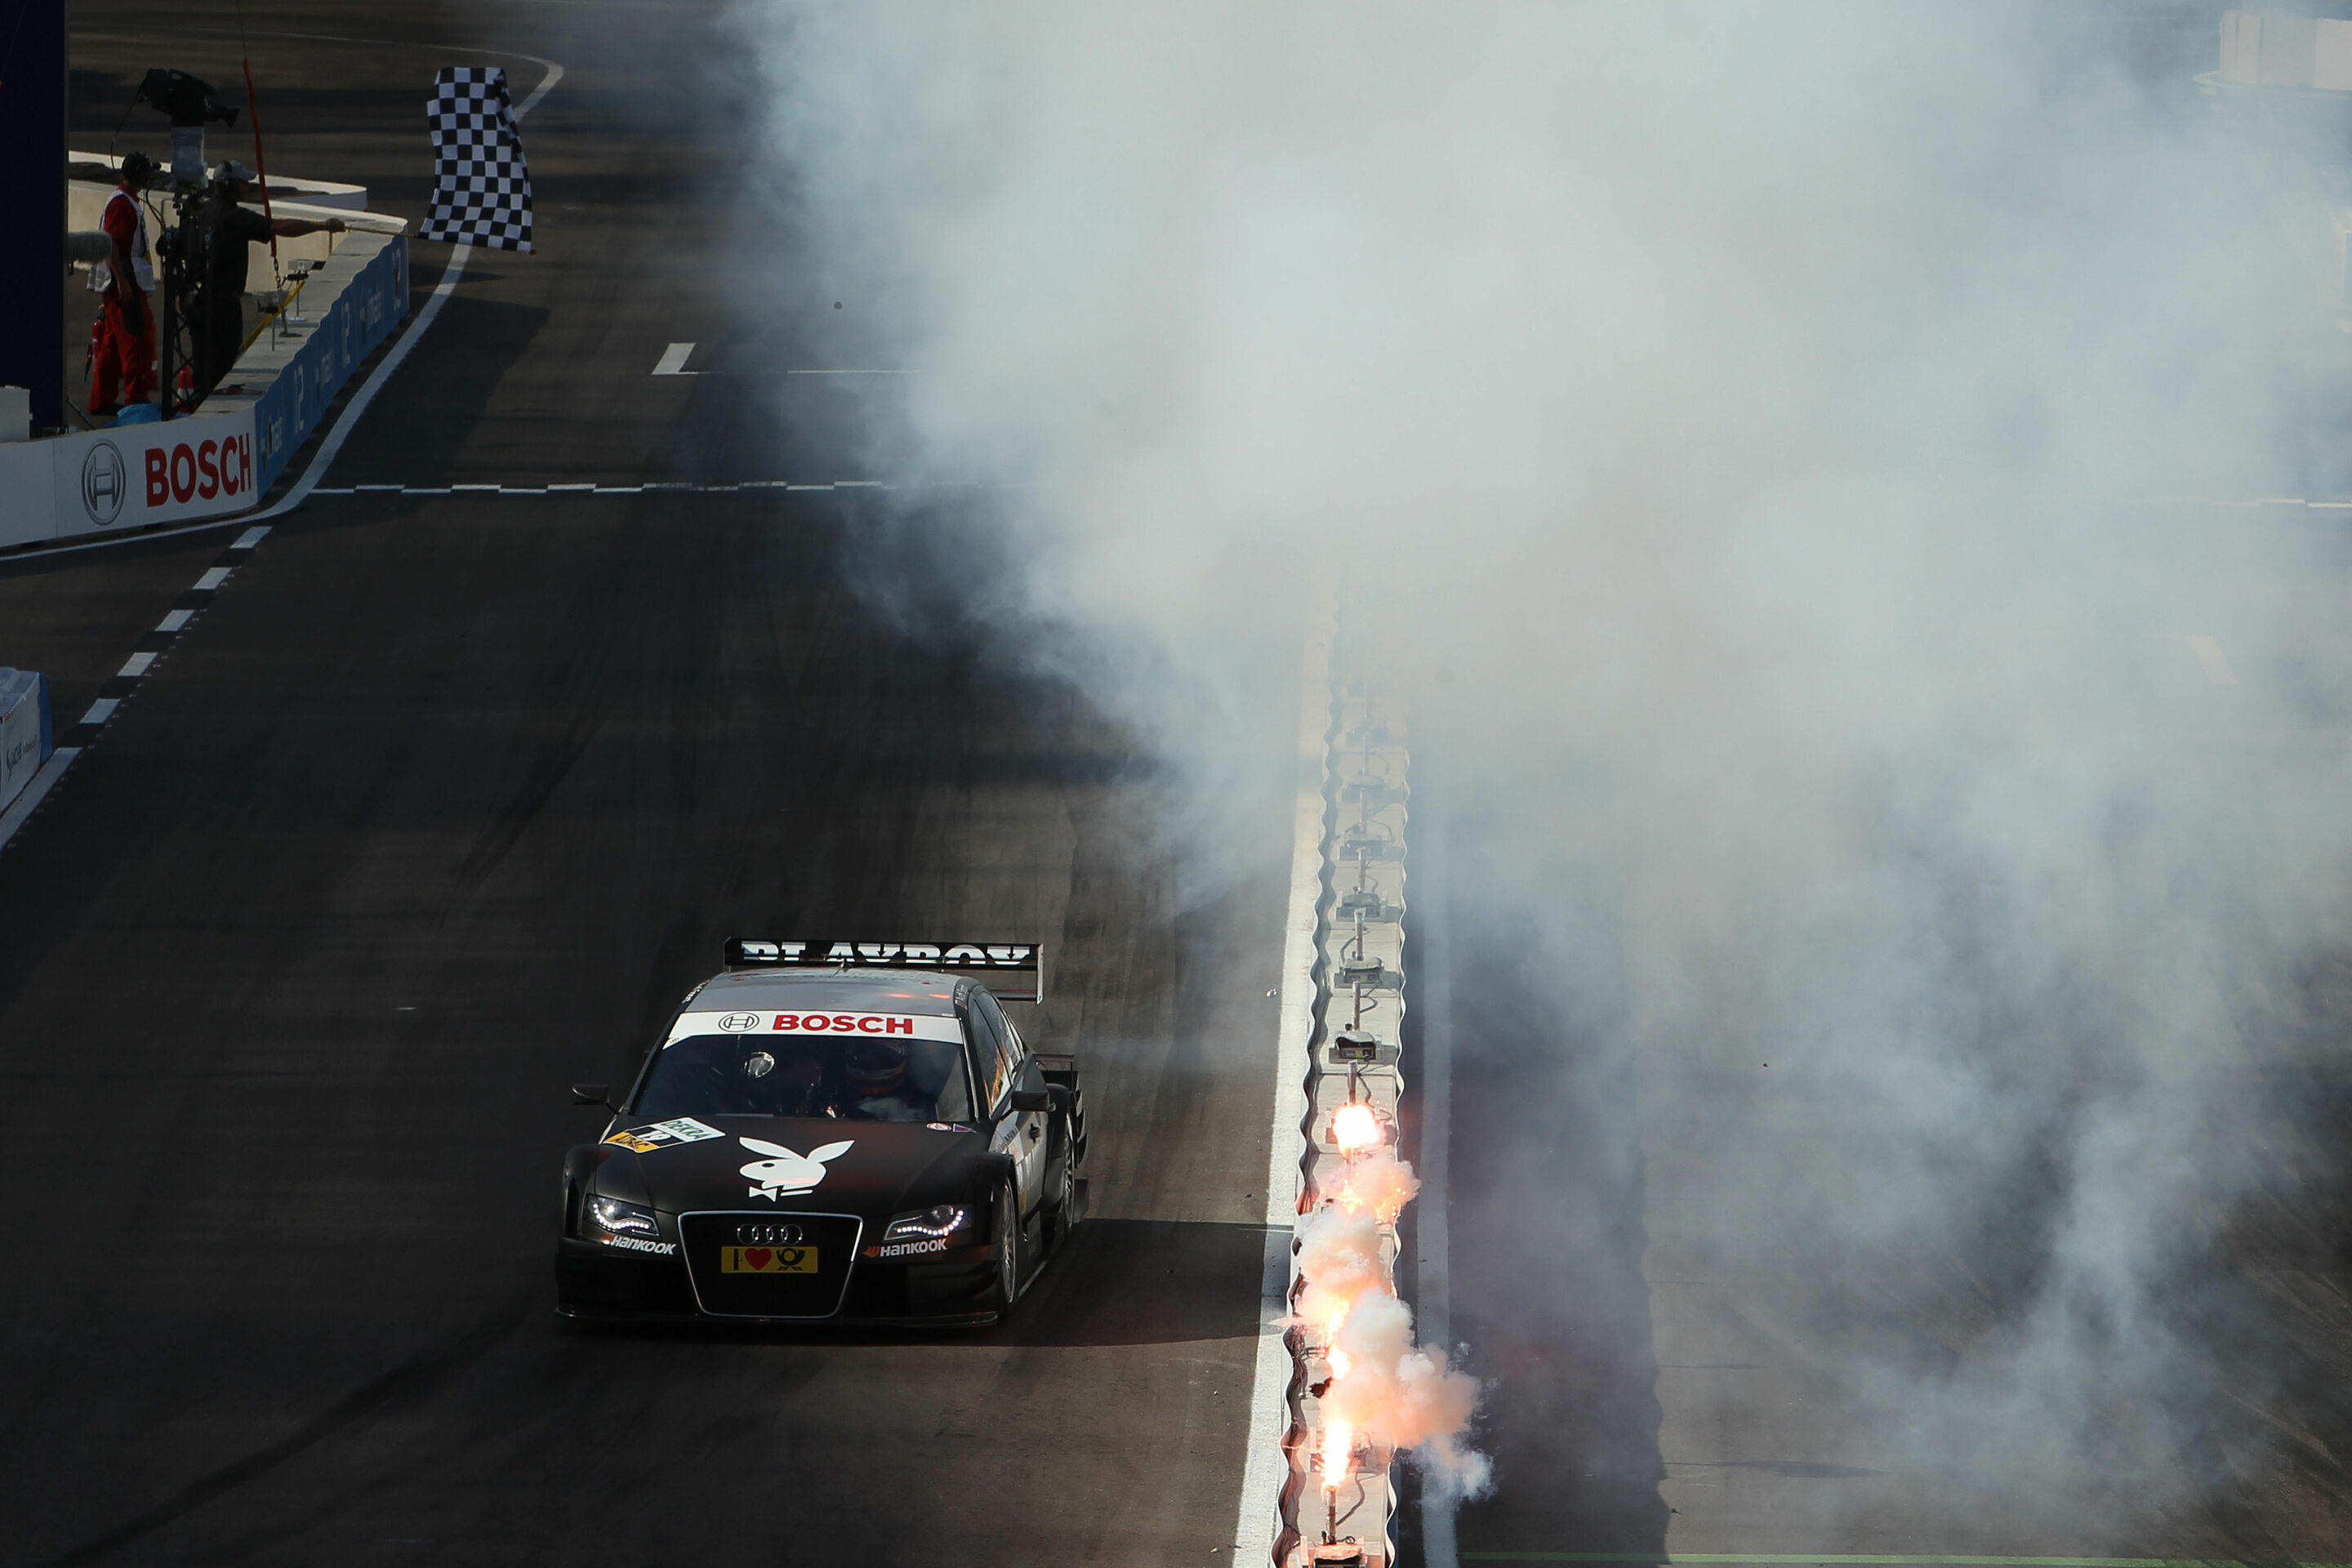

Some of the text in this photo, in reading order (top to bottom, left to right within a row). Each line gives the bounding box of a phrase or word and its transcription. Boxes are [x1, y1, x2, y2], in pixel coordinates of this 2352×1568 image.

[145, 432, 252, 507] BOSCH
[773, 1014, 913, 1035] BOSCH
[661, 1120, 712, 1140] DEKRA
